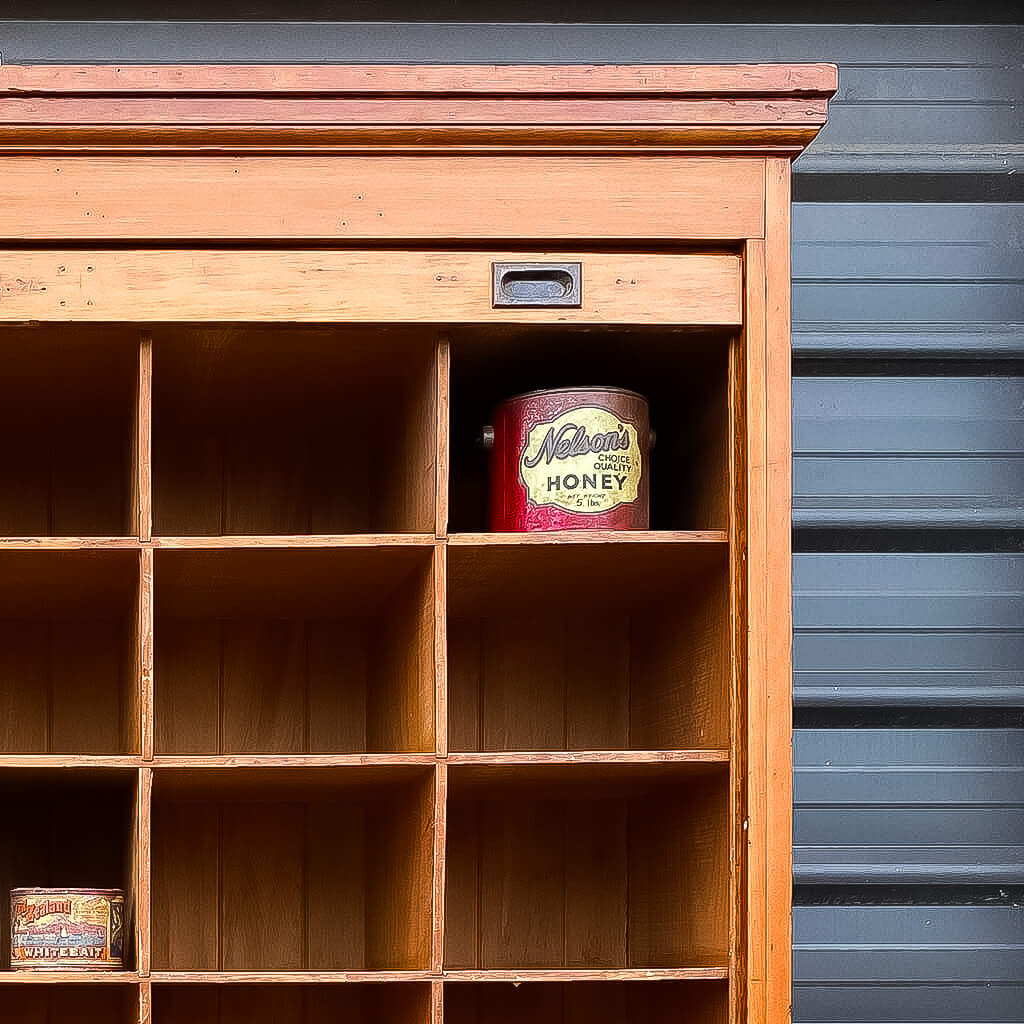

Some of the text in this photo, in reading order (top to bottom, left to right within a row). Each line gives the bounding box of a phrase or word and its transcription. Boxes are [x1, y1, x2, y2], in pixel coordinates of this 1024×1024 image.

[524, 423, 630, 468] Nelson's
[598, 453, 631, 463] CHOICE
[593, 462, 632, 472] QUALITY
[547, 473, 628, 492] HONEY
[24, 947, 102, 958] WHITEBAIT
